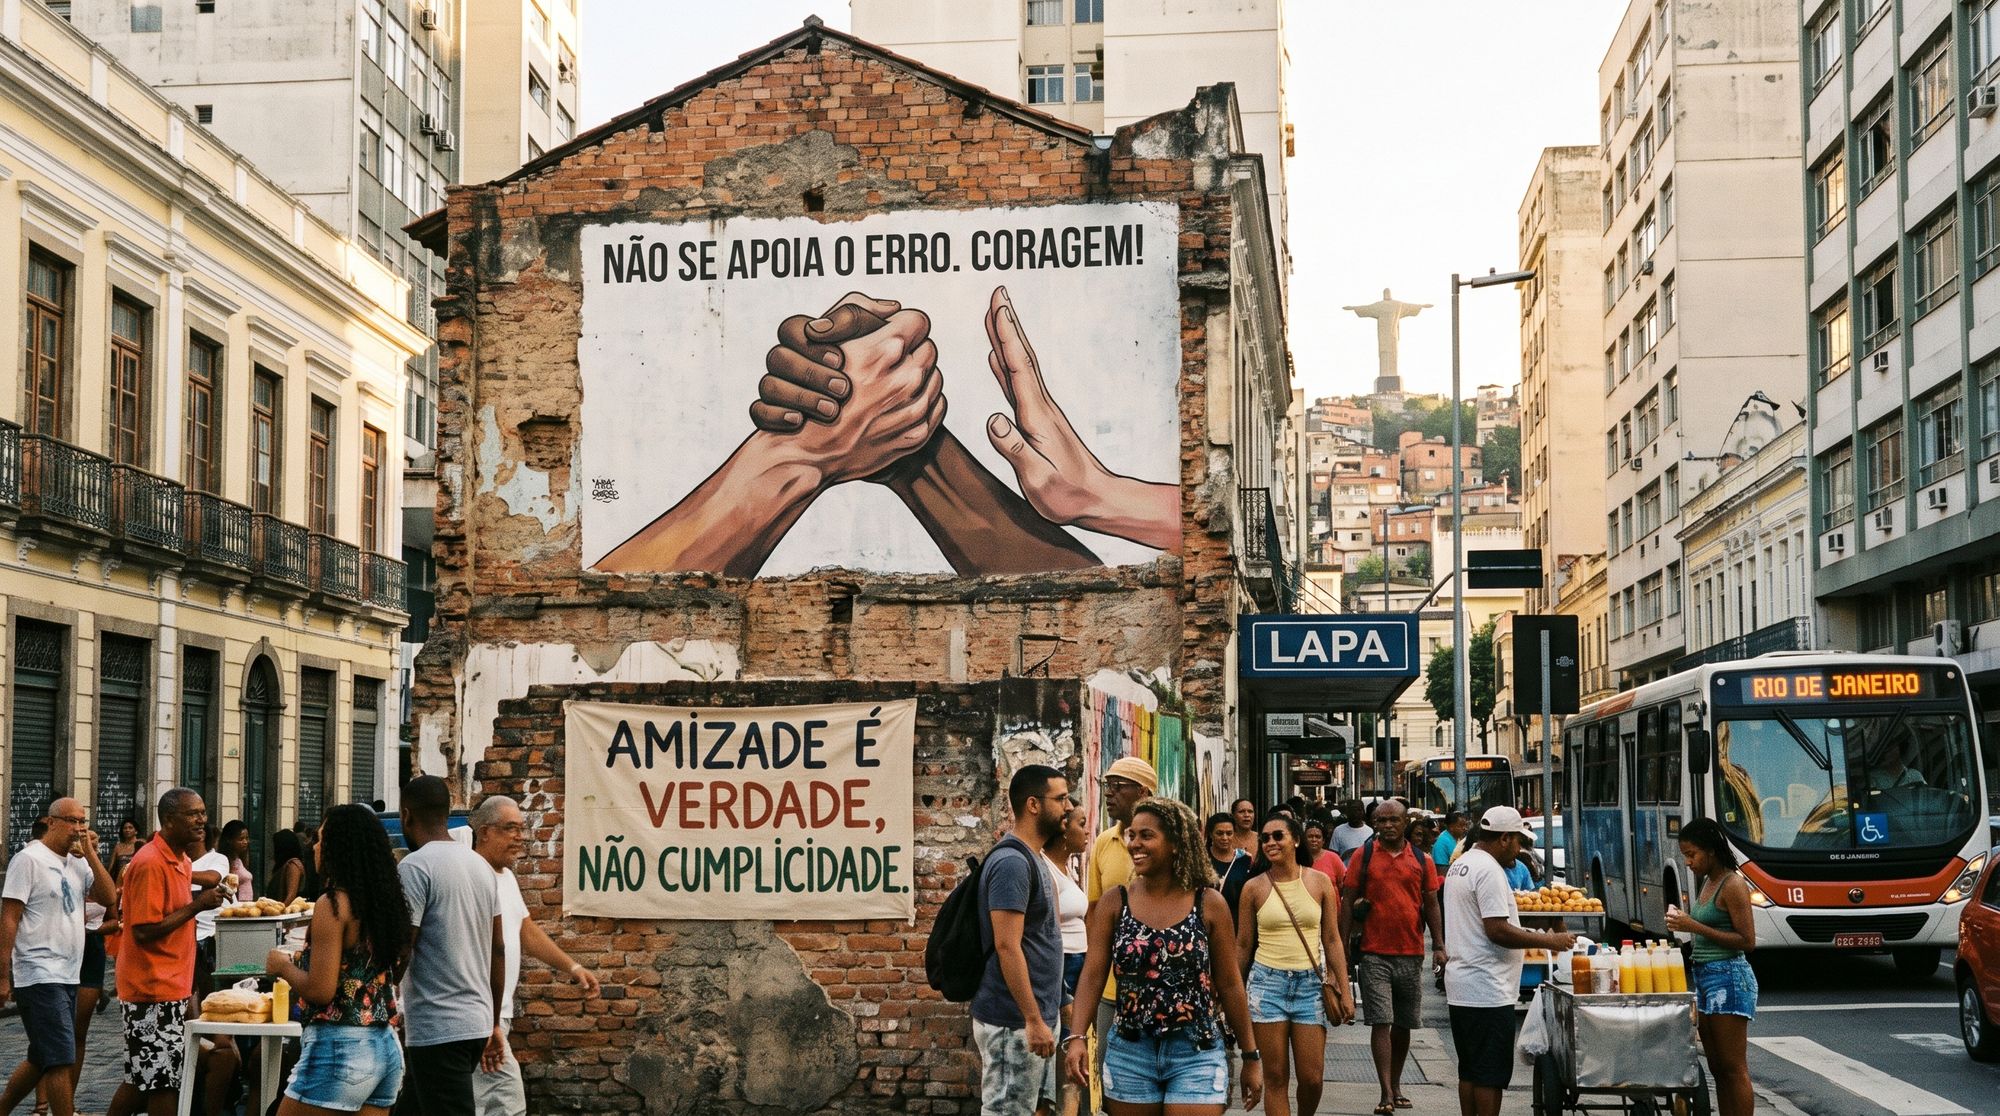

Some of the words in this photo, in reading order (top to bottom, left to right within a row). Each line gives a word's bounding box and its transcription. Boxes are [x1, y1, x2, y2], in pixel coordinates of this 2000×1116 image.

[603, 234, 668, 284] NÃO
[678, 240, 717, 281] SE
[727, 236, 825, 279] APOIA
[835, 235, 855, 276] O
[865, 232, 960, 275] ERRO.
[971, 223, 1144, 271] CORAGEM!
[1271, 629, 1390, 663] LAPA
[1752, 676, 1788, 698] RIO
[1795, 675, 1823, 697] DE
[1829, 673, 1920, 697] JANEIRO
[855, 706, 882, 768] É
[639, 778, 886, 834] VERDADE,
[578, 834, 646, 892] NÃO
